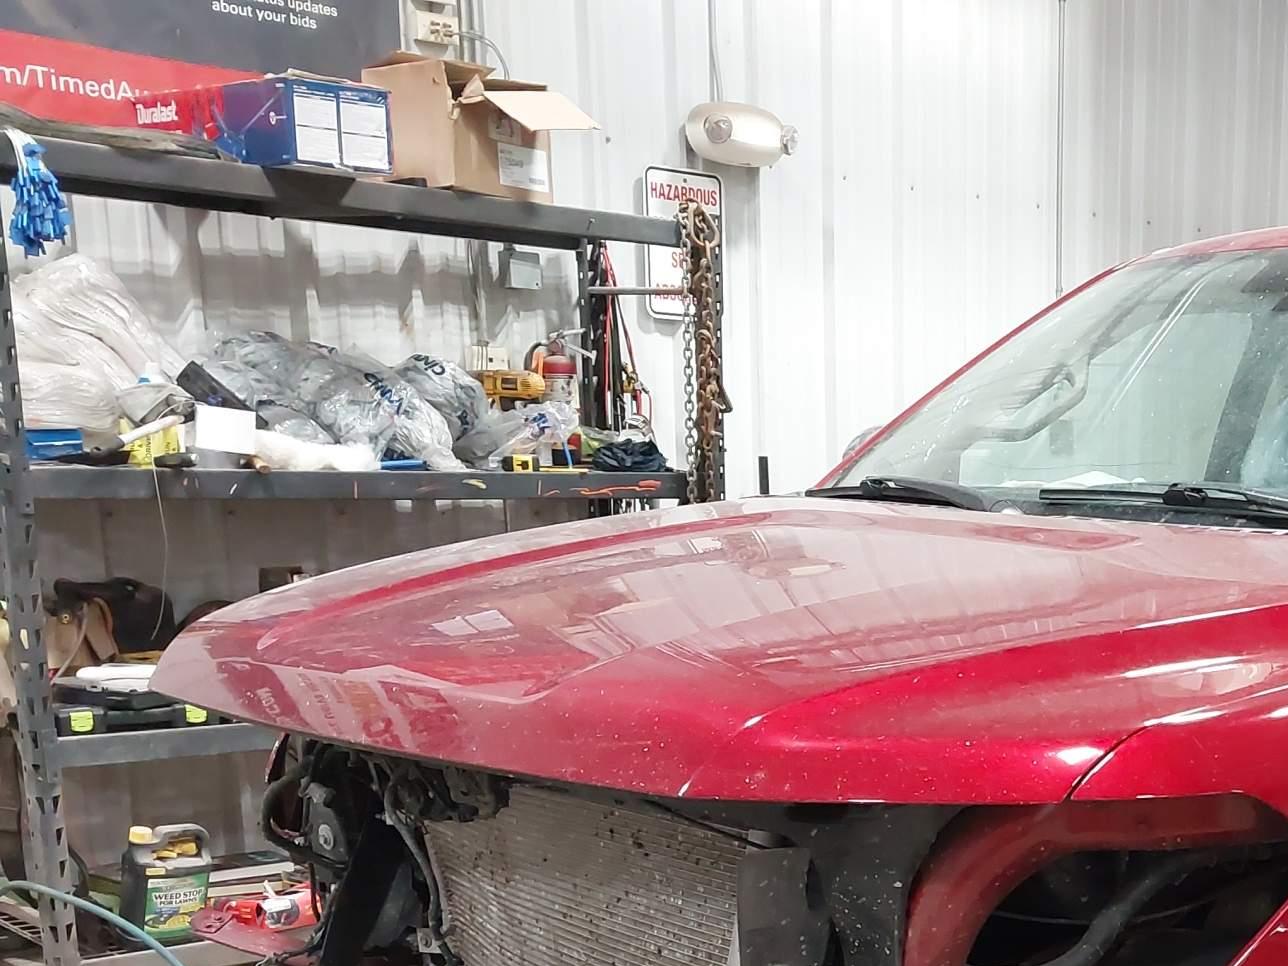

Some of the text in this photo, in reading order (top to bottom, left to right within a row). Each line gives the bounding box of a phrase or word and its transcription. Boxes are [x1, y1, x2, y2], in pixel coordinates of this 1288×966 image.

[212, 1, 253, 17] about
[256, 9, 286, 22] your
[290, 13, 317, 29] bids
[288, 0, 337, 17] updates
[136, 100, 178, 125] Duralast
[650, 182, 717, 207] HAZARDOUS
[154, 889, 203, 901] WEED STOP
